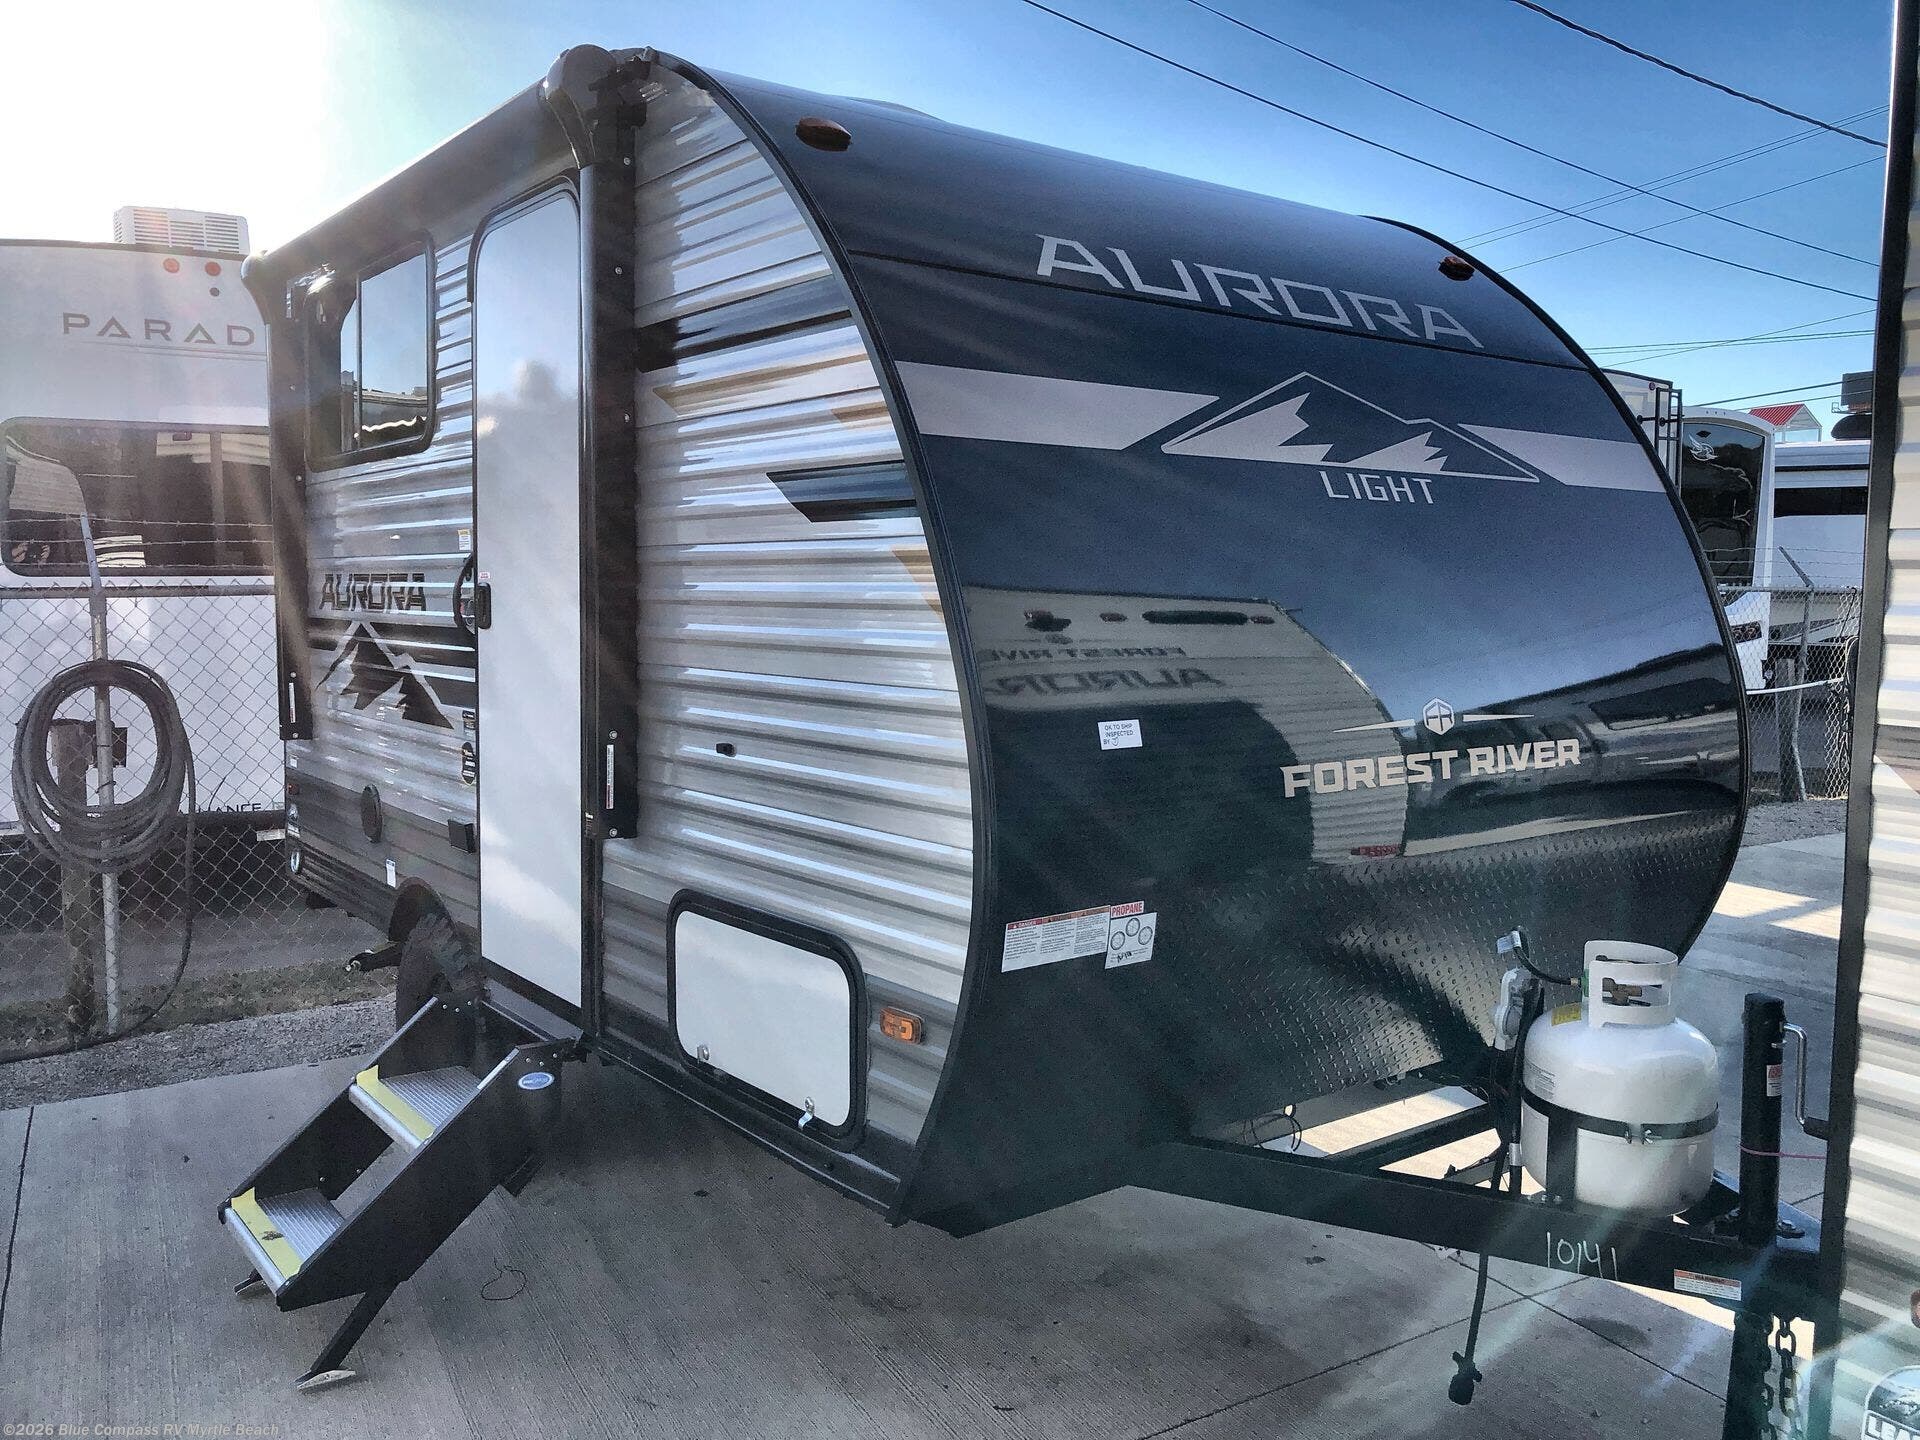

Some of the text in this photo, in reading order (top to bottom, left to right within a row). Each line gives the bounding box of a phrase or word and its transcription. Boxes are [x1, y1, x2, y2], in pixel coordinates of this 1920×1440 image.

[1035, 233, 1484, 348] AURORA
[1319, 470, 1434, 504] LIGHT
[319, 573, 427, 611] AURORA
[1279, 739, 1582, 798] FOREST RIVER
[1111, 902, 1143, 917] PROPANE
[1546, 1231, 1618, 1281] 10141
